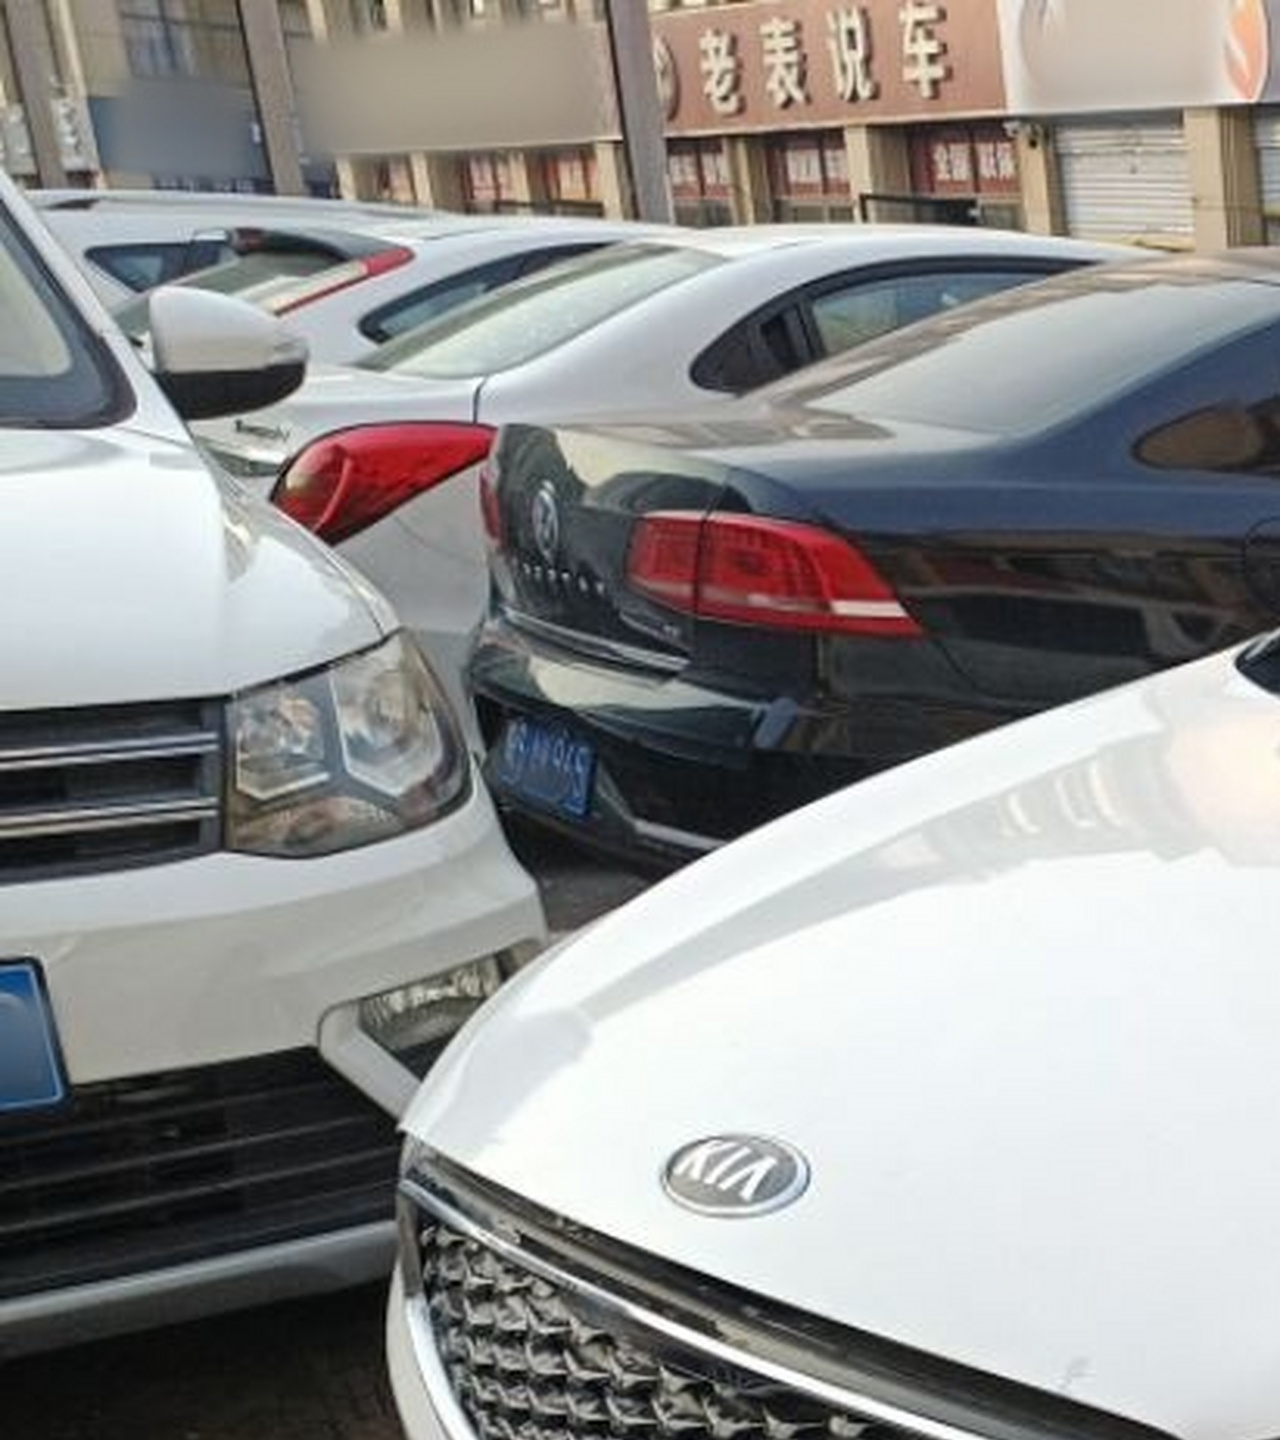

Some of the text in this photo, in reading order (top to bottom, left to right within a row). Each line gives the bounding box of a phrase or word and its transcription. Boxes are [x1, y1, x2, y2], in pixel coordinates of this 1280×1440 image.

[700, 2, 947, 115] 老表说车
[673, 1141, 778, 1200] KIA
